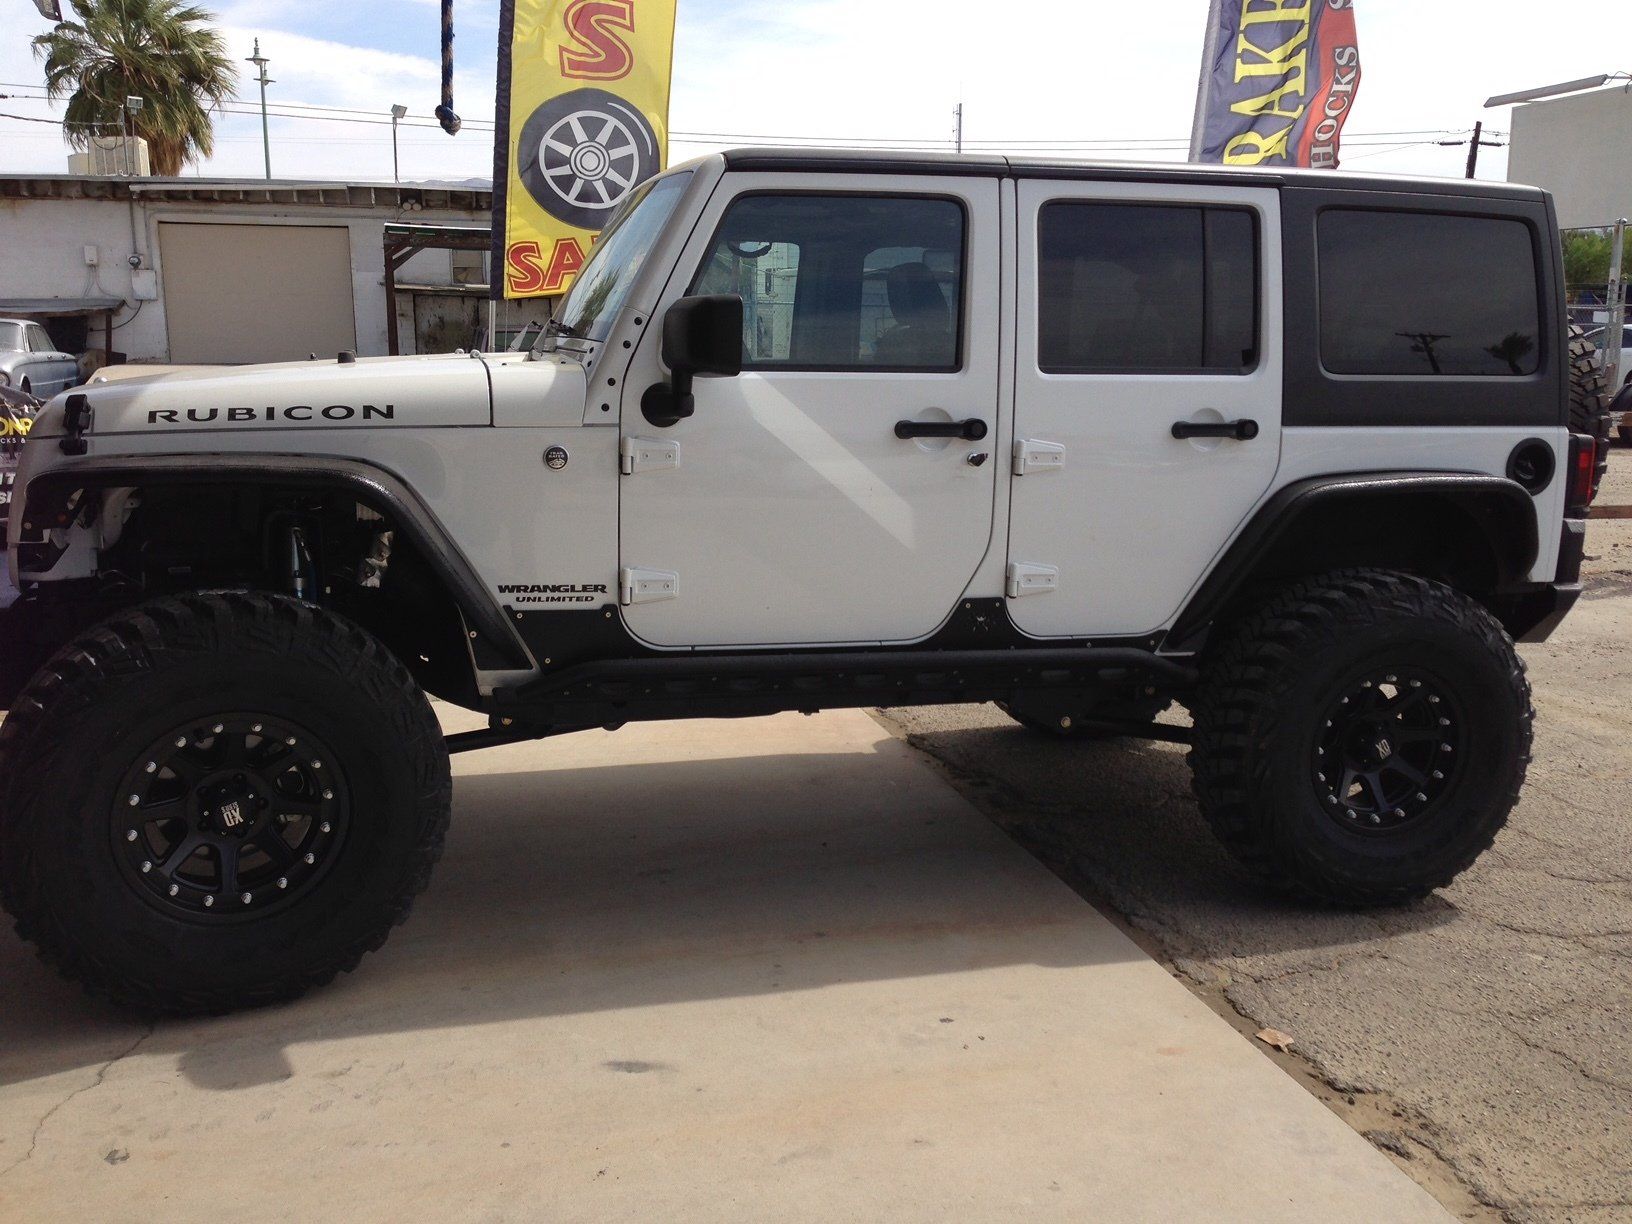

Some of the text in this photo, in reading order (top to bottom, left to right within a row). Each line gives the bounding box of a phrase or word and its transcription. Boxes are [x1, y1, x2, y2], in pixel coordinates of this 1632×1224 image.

[507, 235, 600, 293] SA
[148, 405, 394, 423] RUBICON
[498, 584, 608, 593] WRANGLER
